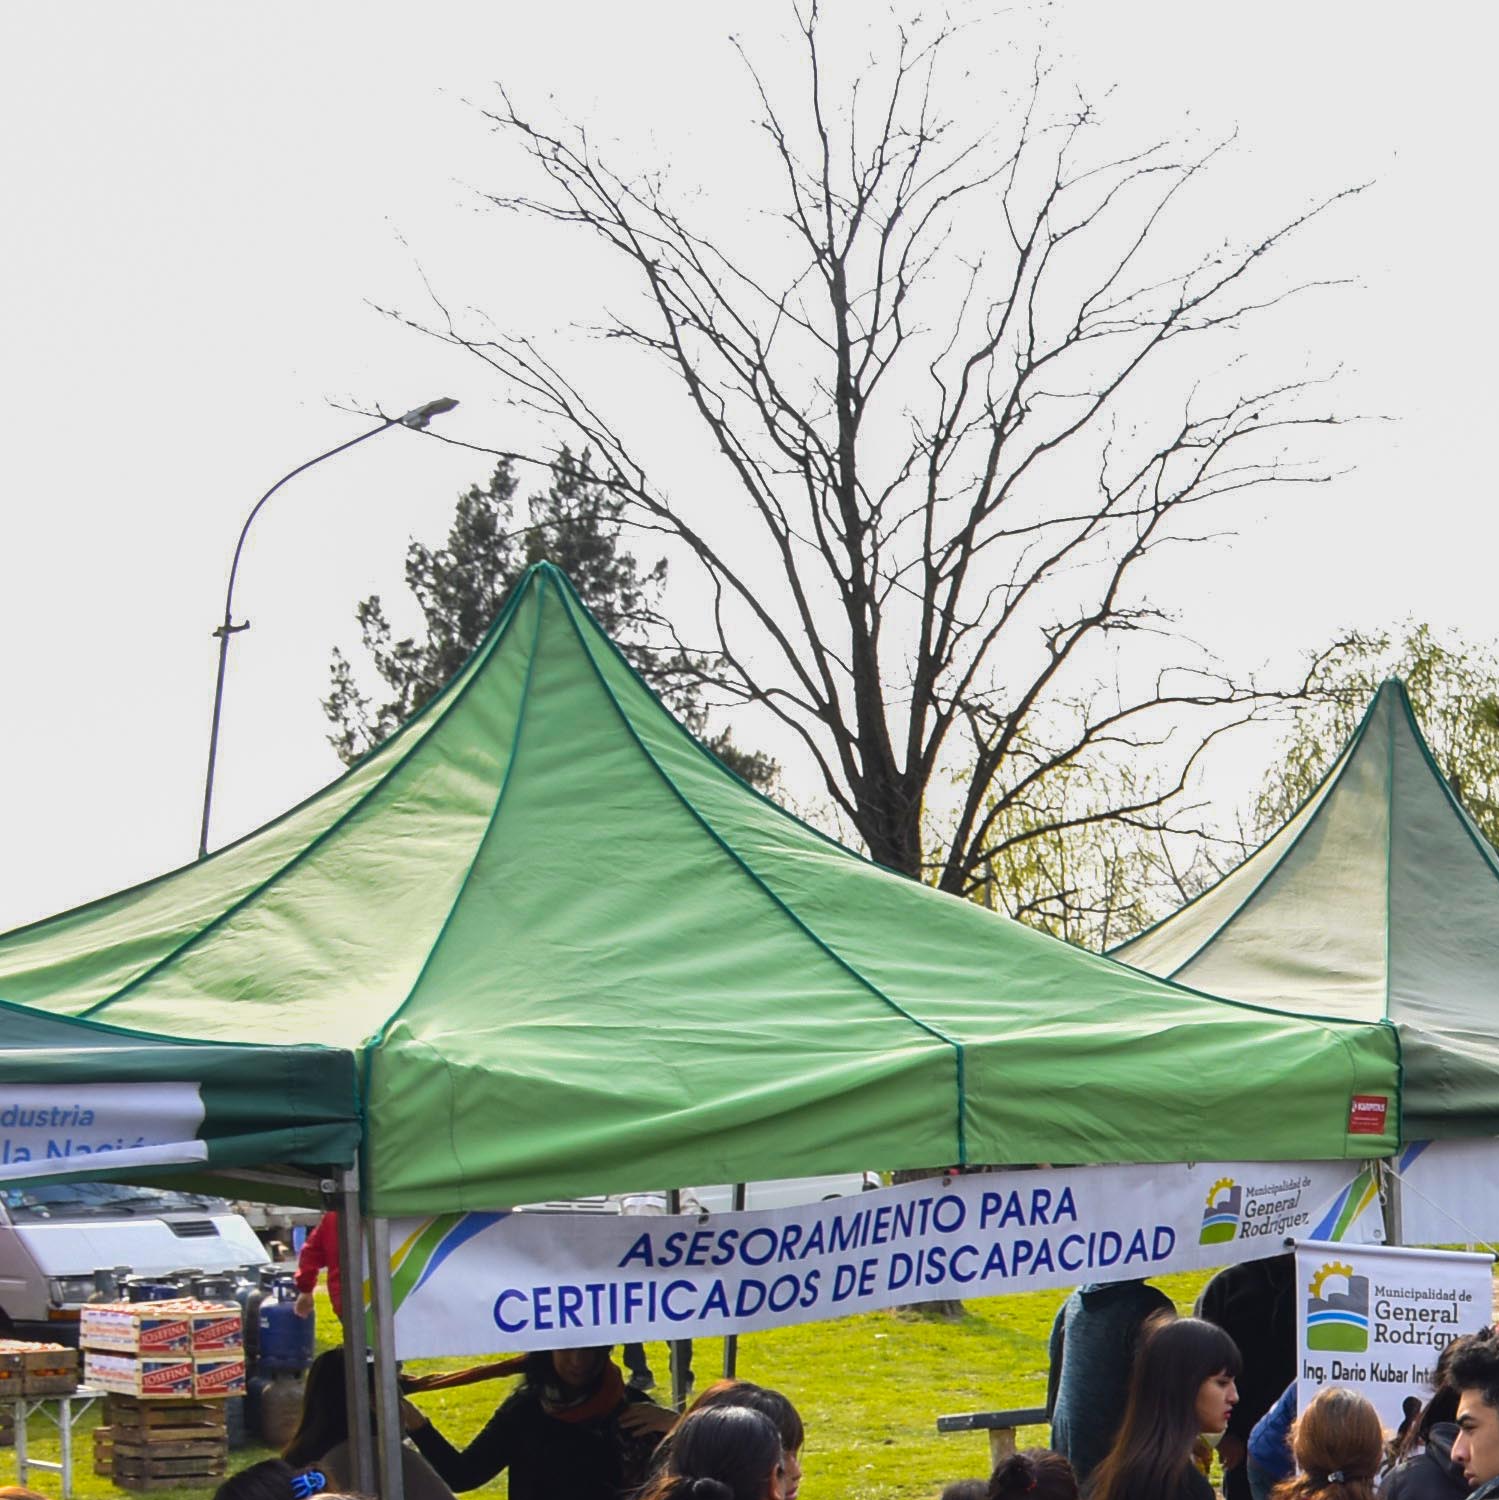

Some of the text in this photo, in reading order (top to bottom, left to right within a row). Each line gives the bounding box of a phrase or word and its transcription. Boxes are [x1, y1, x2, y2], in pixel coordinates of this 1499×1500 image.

[1246, 1176, 1311, 1198] Municipalidad de
[1245, 1190, 1302, 1218] General
[617, 1186, 1077, 1268] ASESORAMIENTO PARA
[1239, 1212, 1310, 1239] Rodríguez
[493, 1225, 1176, 1333] CERTIFICADOS DE DISCAPACIDAD
[1375, 1286, 1472, 1302] Municipalidad de
[1375, 1300, 1459, 1324] General
[141, 1324, 186, 1343] JOSEFINA
[196, 1320, 240, 1342] JOSEFINA
[143, 1366, 190, 1386] JOSEFINA
[198, 1365, 243, 1387] JOSEFINA
[1303, 1359, 1327, 1385] Ing.
[1332, 1360, 1367, 1382] Dario
[1370, 1362, 1408, 1384] Kubar
